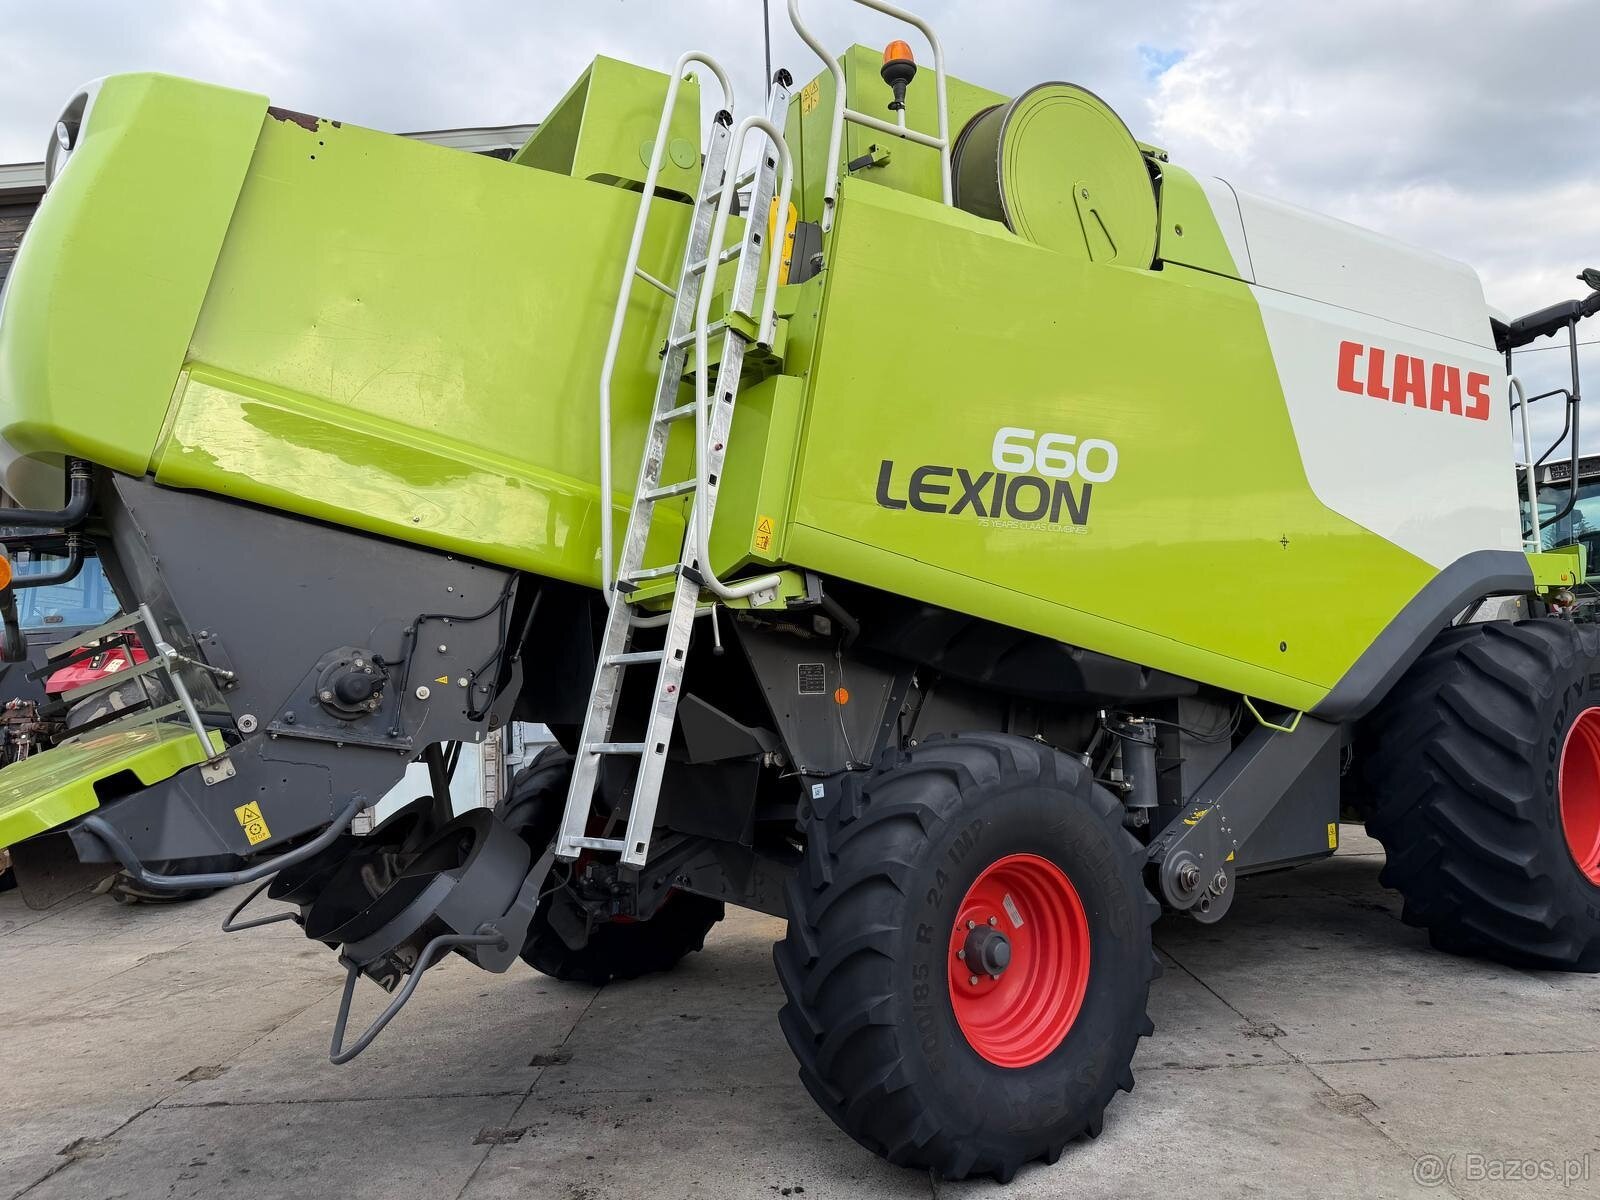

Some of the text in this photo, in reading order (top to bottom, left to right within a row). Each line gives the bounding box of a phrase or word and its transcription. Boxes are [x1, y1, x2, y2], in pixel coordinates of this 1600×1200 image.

[1337, 340, 1490, 421] CLAAS
[992, 426, 1119, 483] 660
[875, 459, 1092, 526] LEXION
[977, 518, 990, 529] 75
[991, 519, 1018, 530] YEARS
[1020, 521, 1047, 531] CLAAS
[250, 832, 266, 842] STOP
[916, 922, 935, 945] R
[926, 867, 951, 909] 24
[948, 818, 984, 865] IMP
